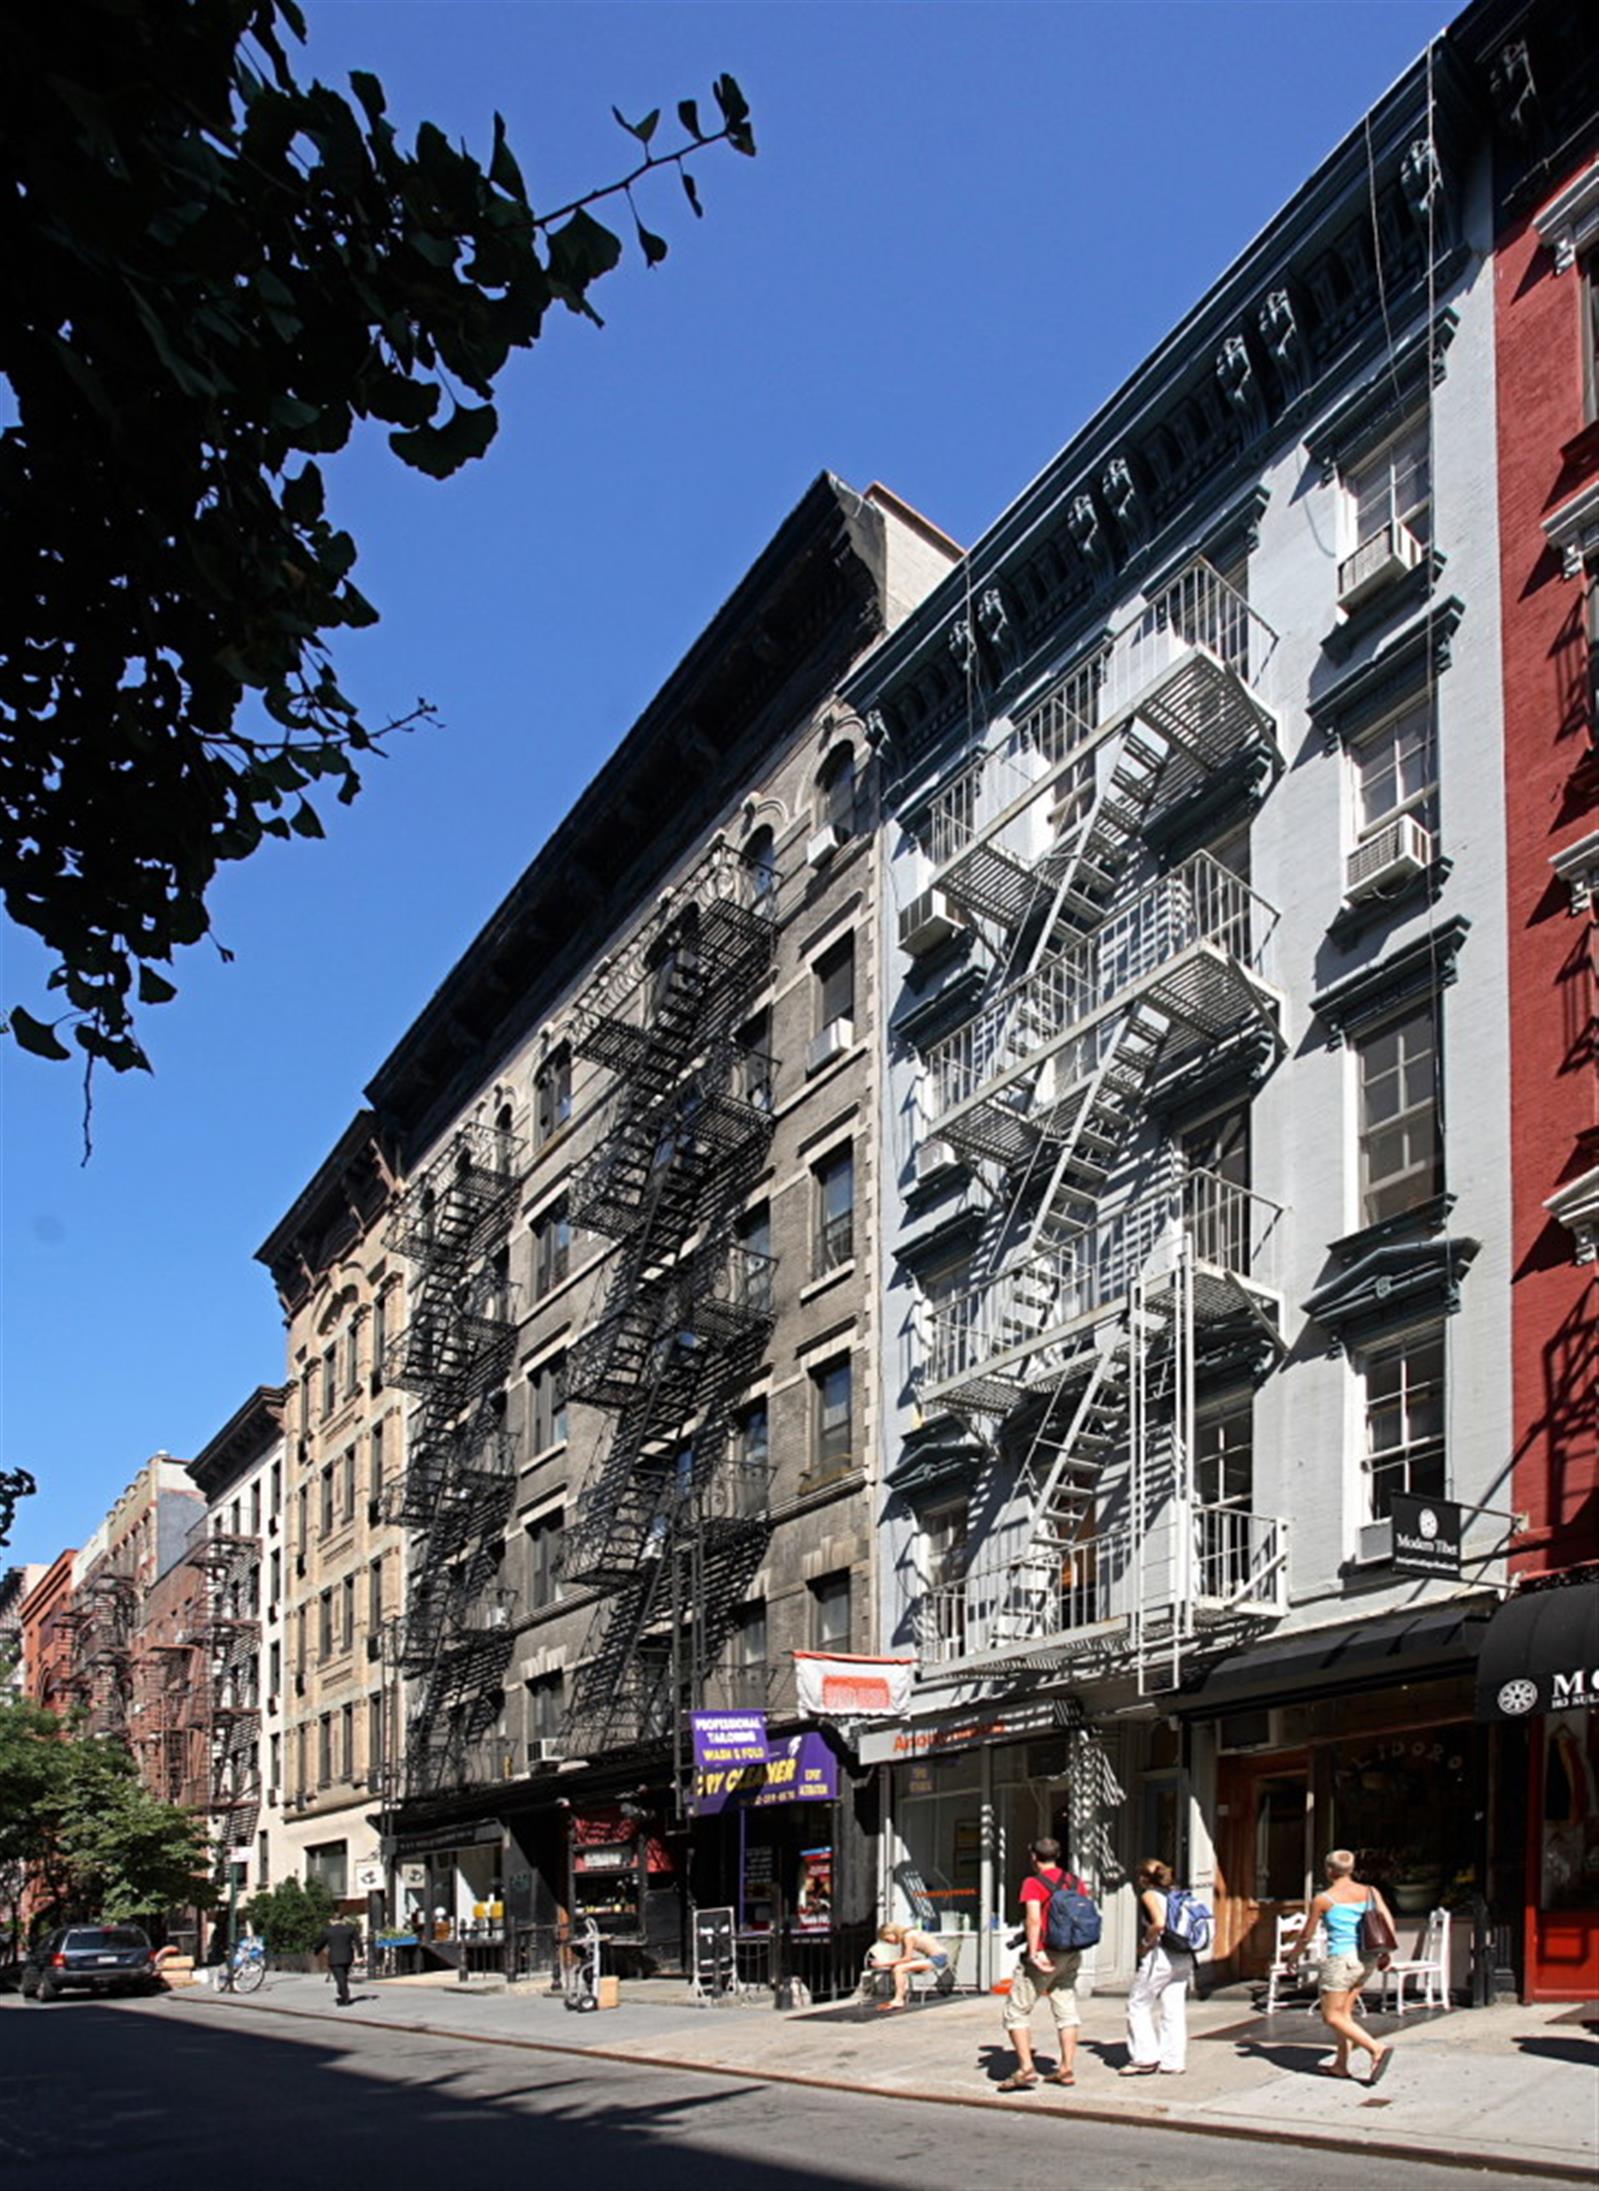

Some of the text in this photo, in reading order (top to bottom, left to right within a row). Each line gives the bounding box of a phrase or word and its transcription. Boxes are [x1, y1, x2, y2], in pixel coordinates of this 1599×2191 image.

[695, 1717, 761, 1731] PROFESSIONAL
[707, 1731, 756, 1744] TAILORING
[703, 1749, 732, 1761] WASH
